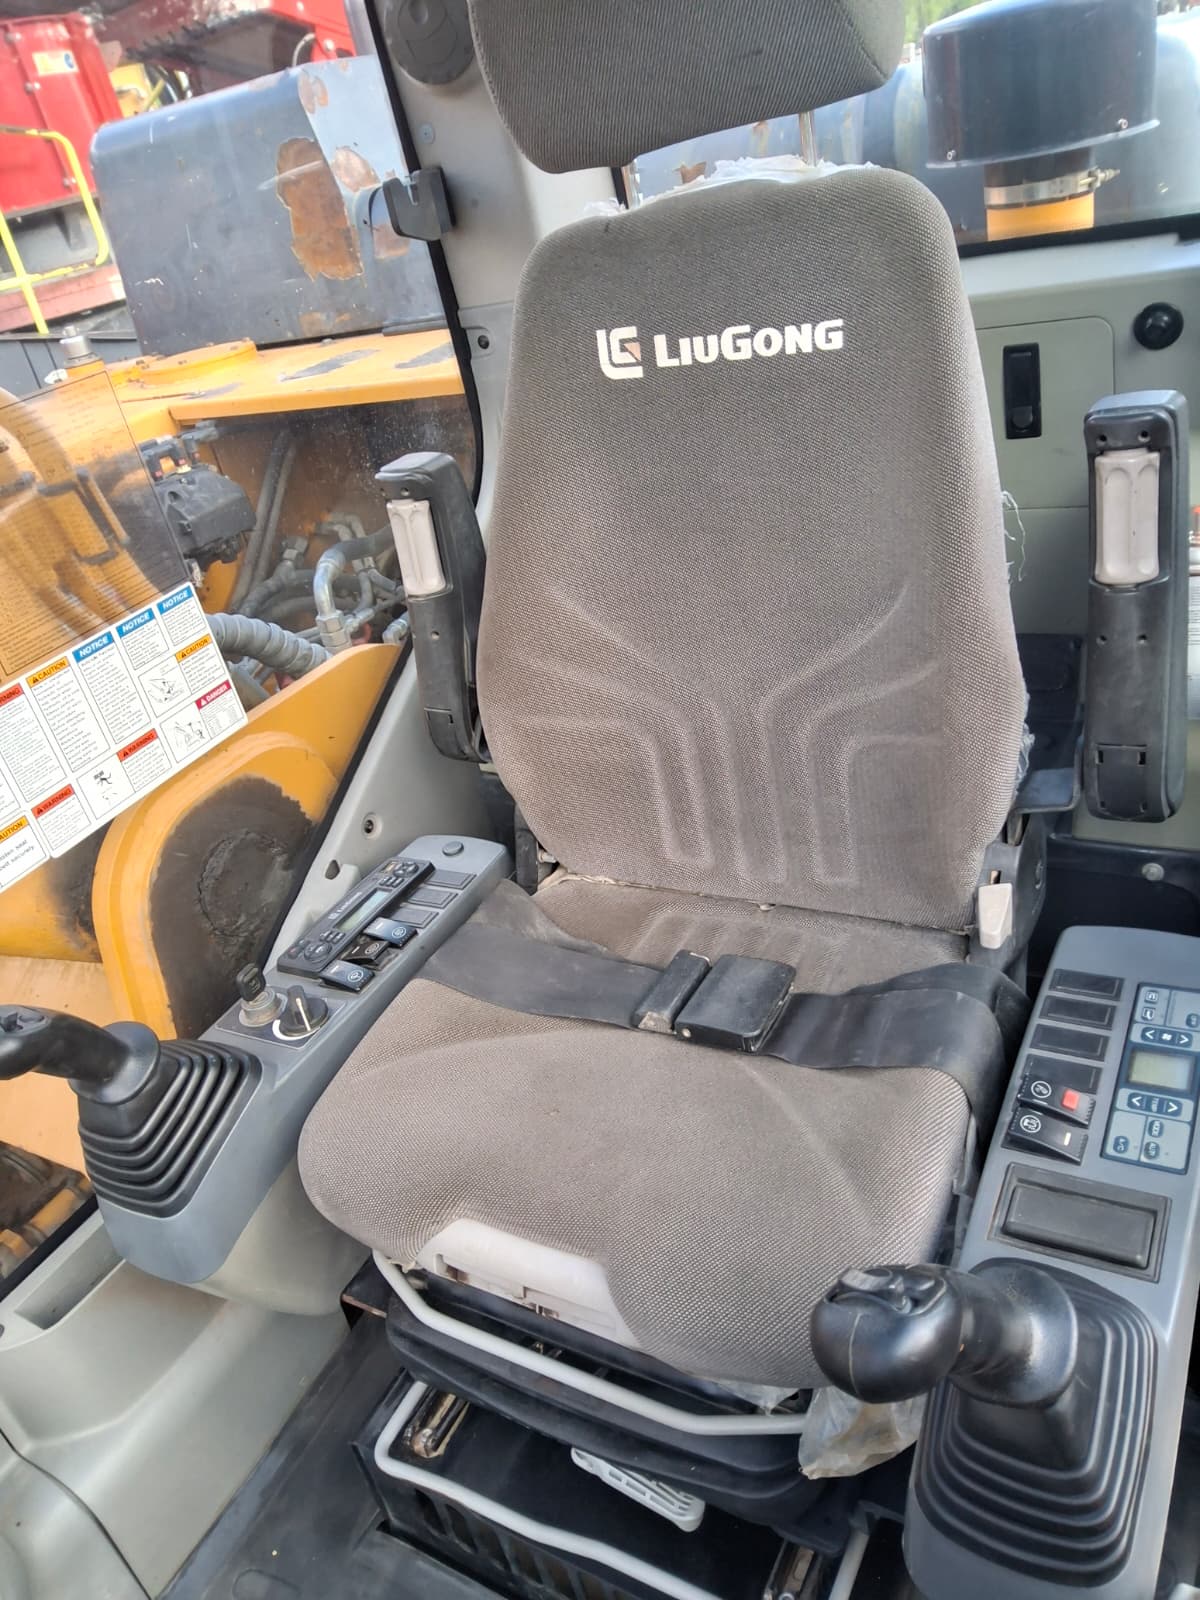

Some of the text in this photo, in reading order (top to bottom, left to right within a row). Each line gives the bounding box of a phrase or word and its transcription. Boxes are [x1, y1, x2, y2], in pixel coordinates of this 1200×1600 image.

[162, 590, 189, 609] NOTICE
[122, 612, 150, 633] NOTICE
[79, 636, 108, 657] NOTICE
[186, 638, 208, 655] CAUTION
[38, 660, 66, 680] CAUTION
[0, 687, 20, 703] RNING
[206, 684, 228, 701] DANGER
[127, 732, 154, 753] WARNING
[42, 788, 71, 810] WARNING
[0, 821, 23, 840] AUTION
